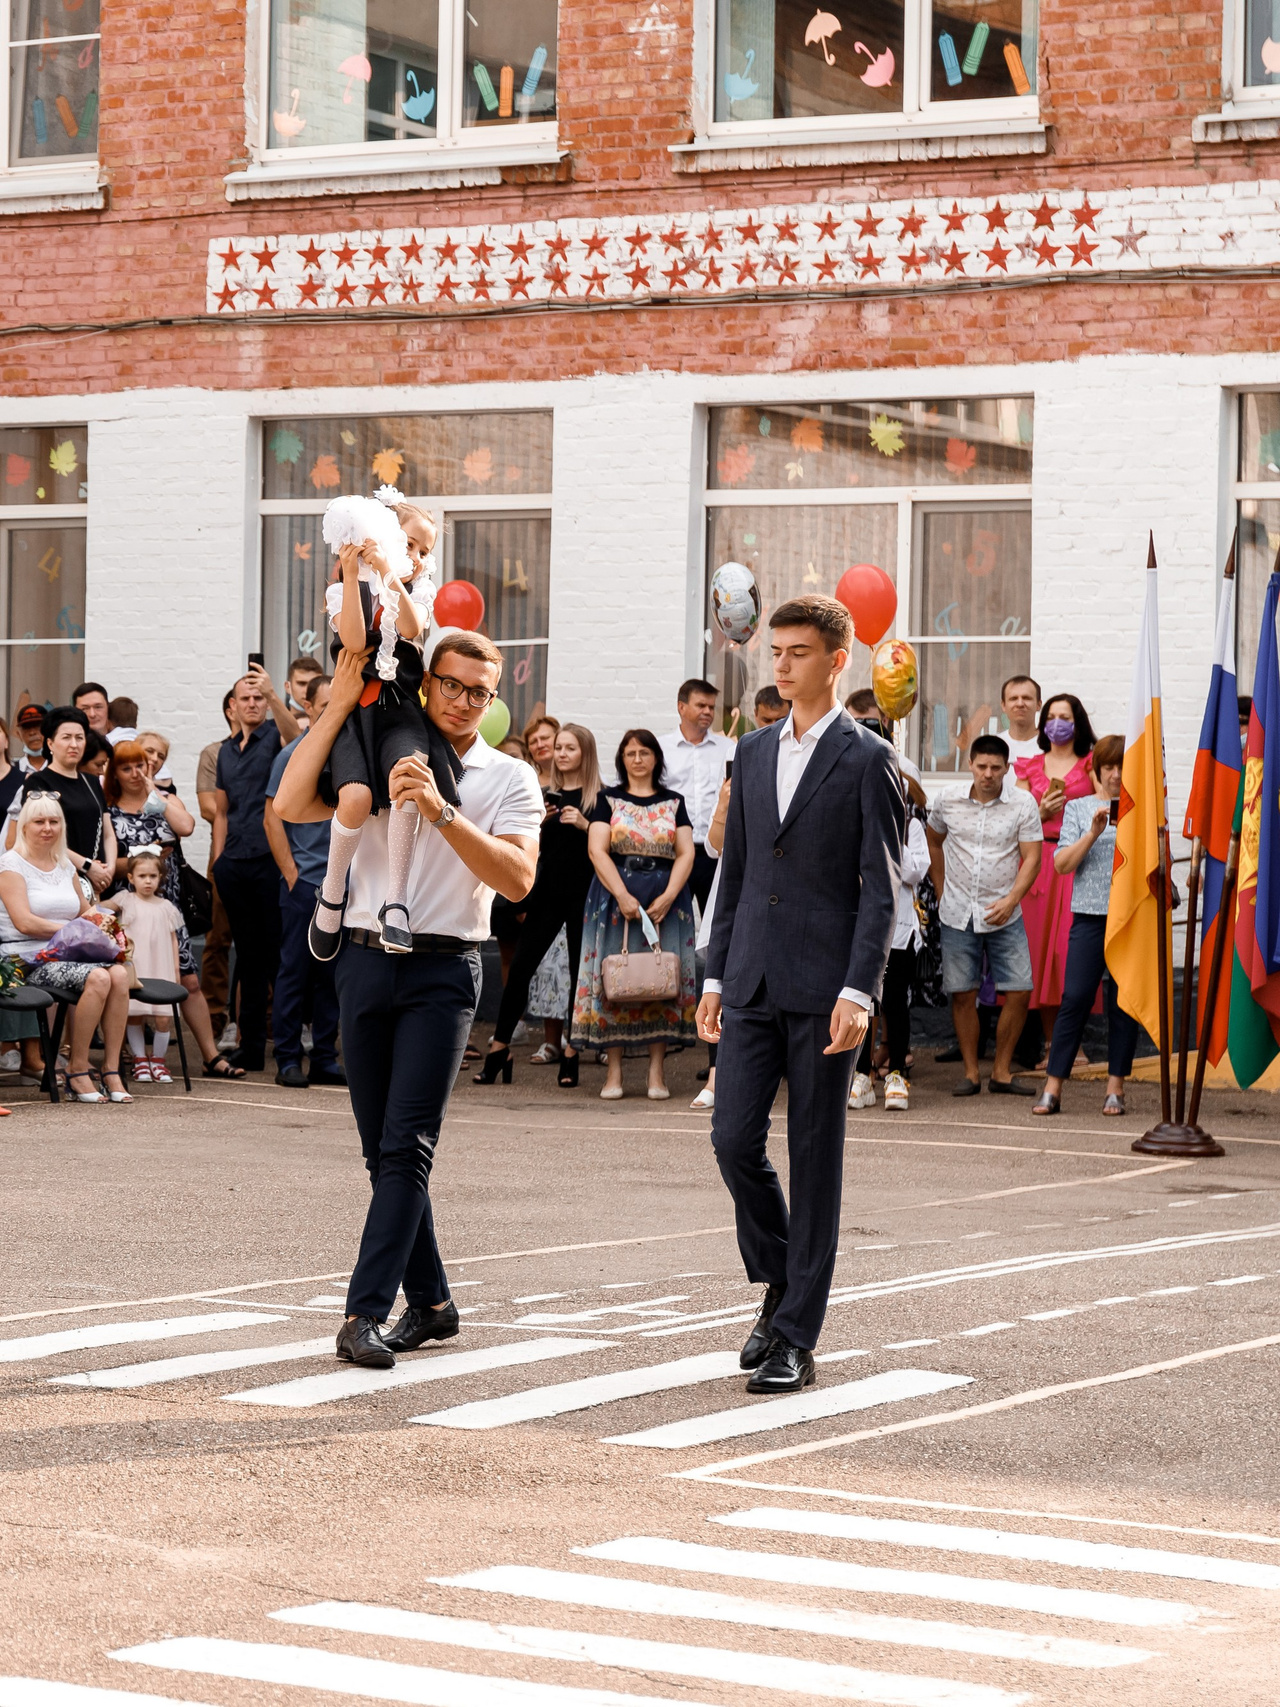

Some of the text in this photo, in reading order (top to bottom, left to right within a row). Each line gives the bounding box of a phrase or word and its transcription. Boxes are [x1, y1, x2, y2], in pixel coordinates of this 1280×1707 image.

[37, 547, 62, 583] 4
[966, 529, 1003, 577] 5
[503, 559, 528, 591] 4
